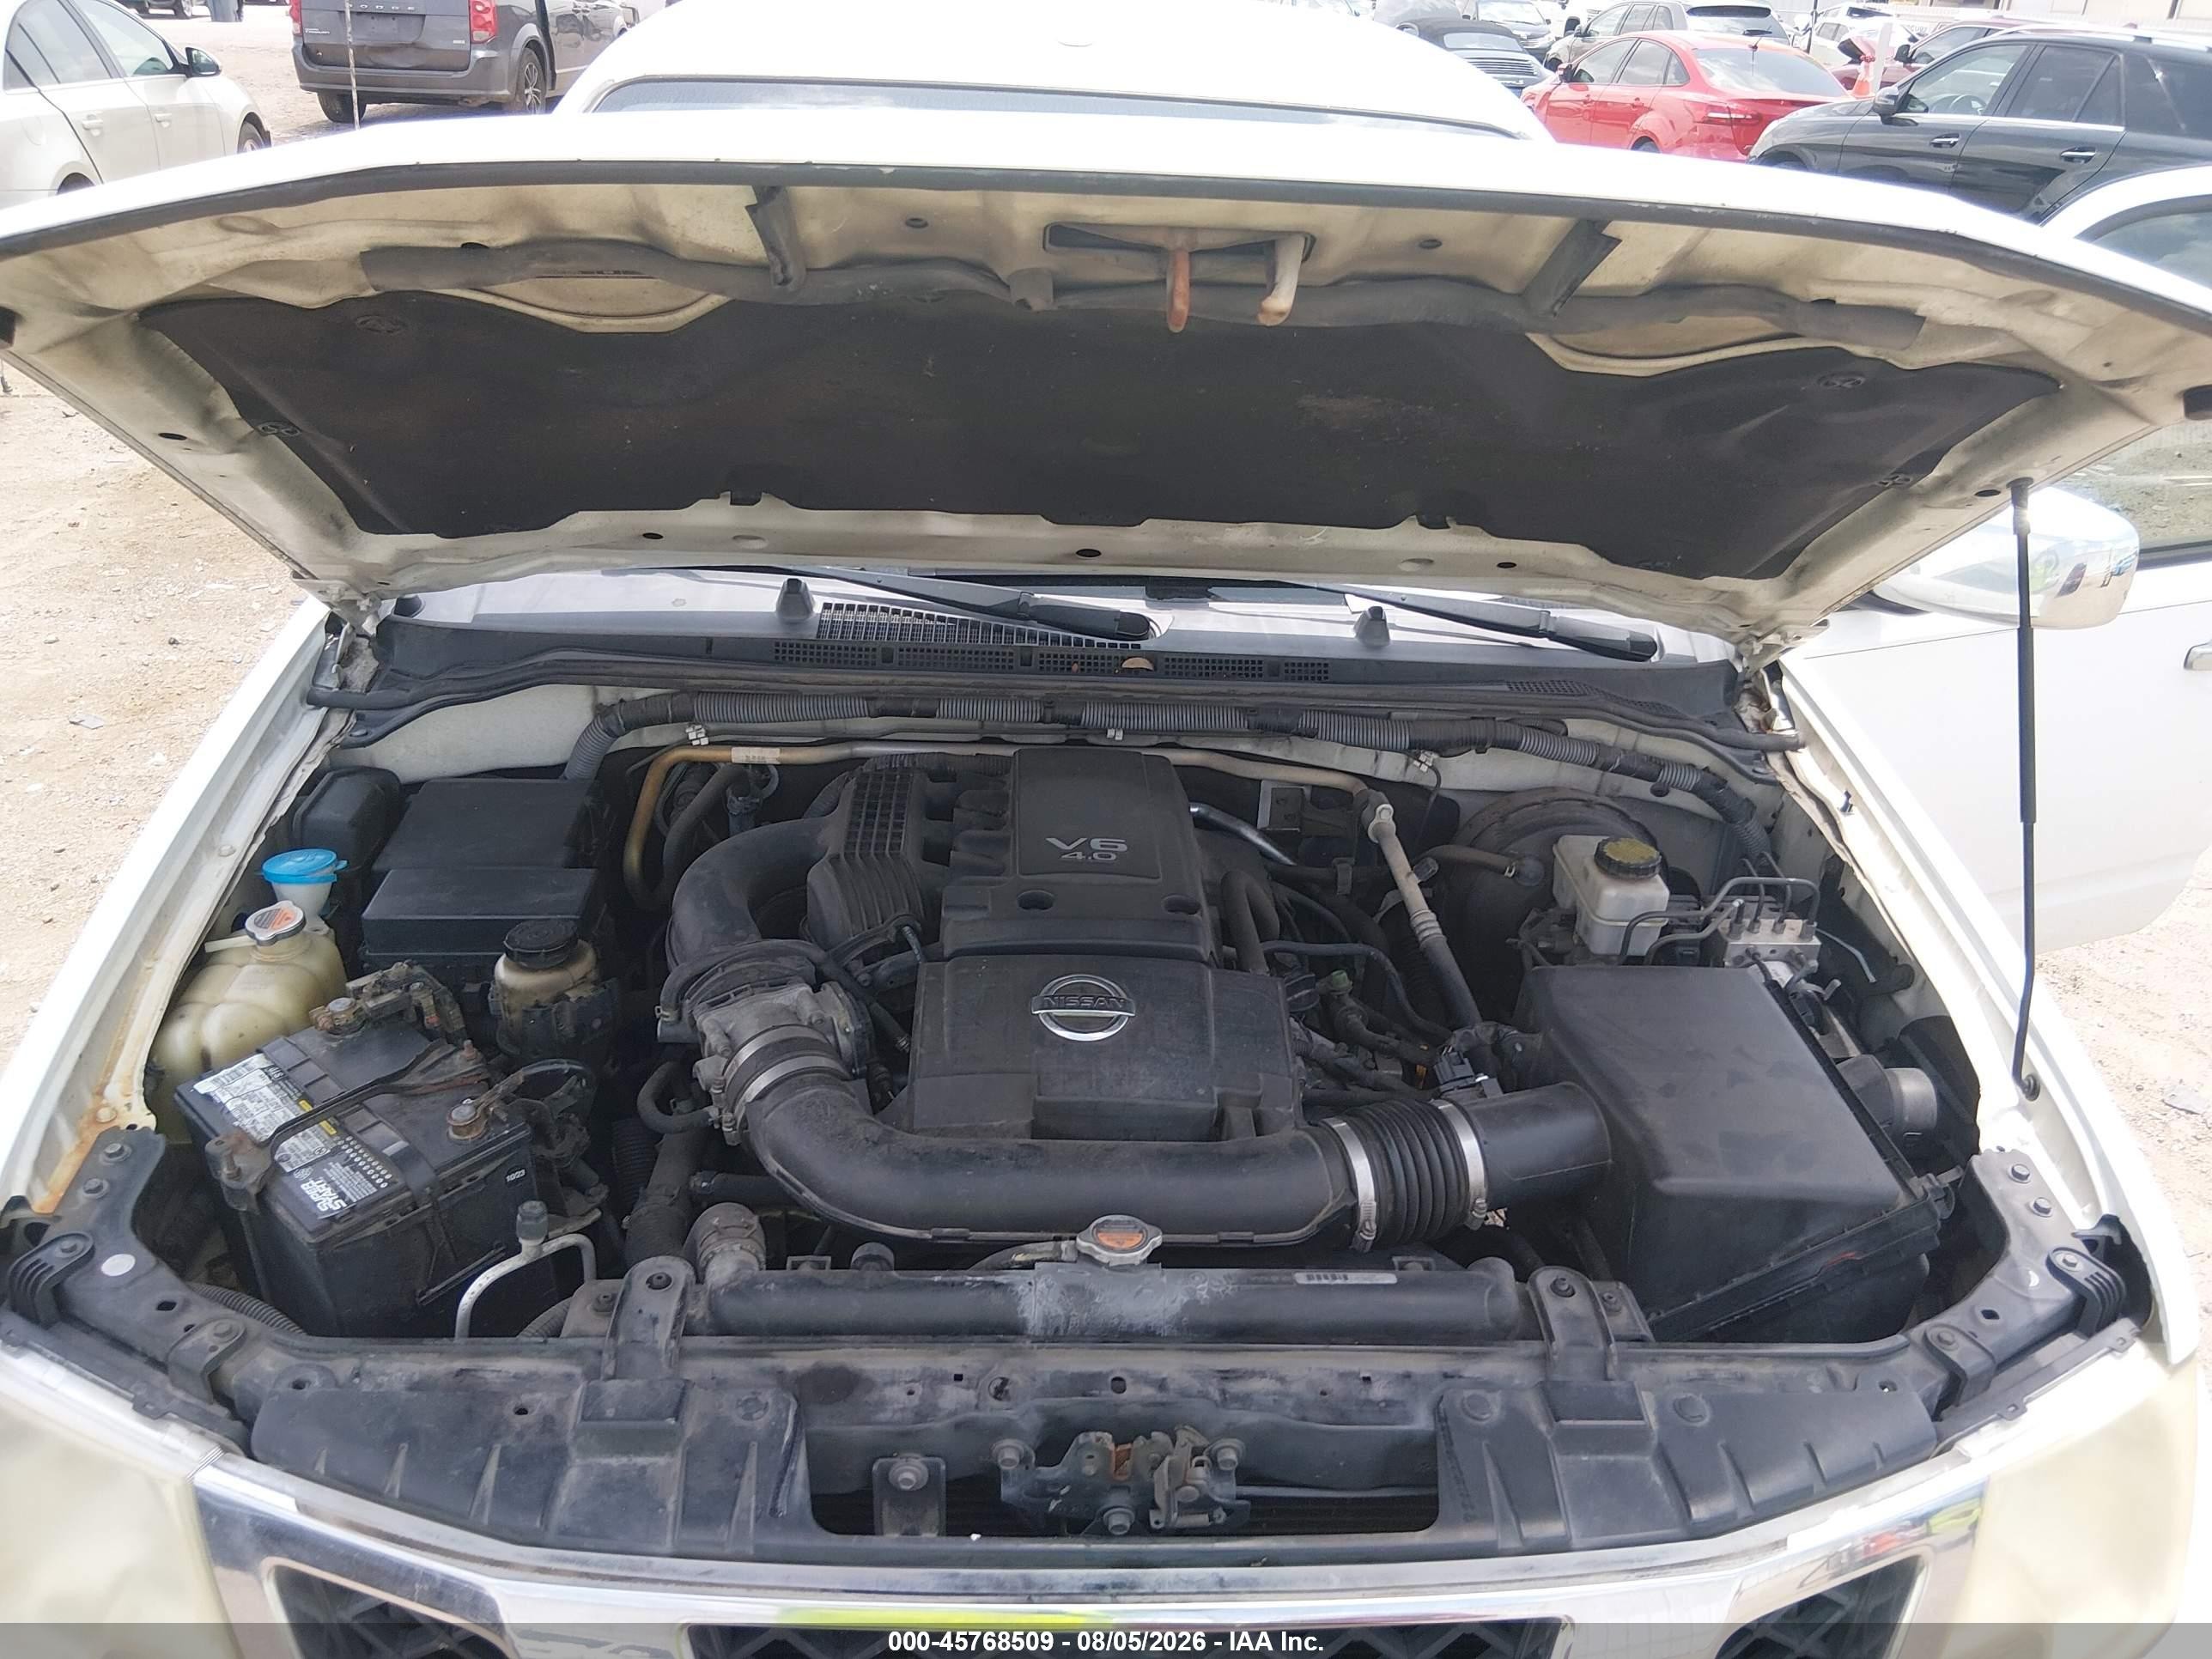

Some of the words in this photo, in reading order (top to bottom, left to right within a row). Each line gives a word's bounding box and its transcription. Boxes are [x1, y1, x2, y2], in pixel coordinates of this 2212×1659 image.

[1045, 837, 1127, 852] V6
[1060, 851, 1117, 861] 4.0
[1043, 996, 1125, 1008] NISSAN
[301, 1179, 331, 1212] SUPER
[316, 1176, 348, 1211] START
